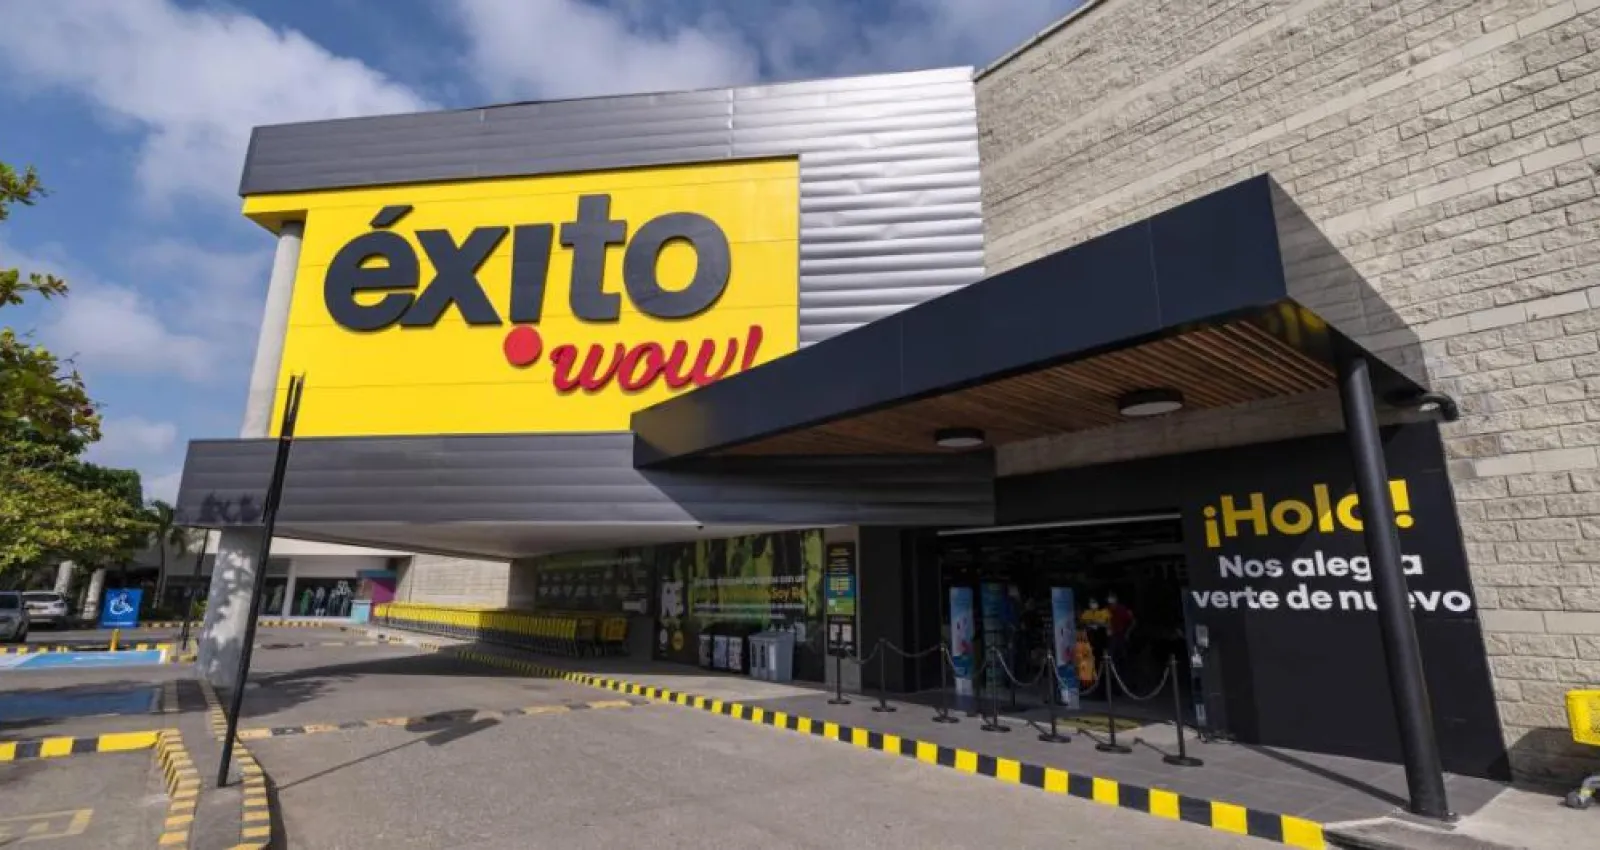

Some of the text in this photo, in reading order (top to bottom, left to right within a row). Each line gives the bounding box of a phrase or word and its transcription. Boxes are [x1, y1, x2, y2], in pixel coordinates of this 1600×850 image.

[323, 193, 732, 367] éxito
[550, 326, 762, 394] wow!
[1219, 555, 1283, 578] Nos
[1291, 550, 1423, 582] alega
[1192, 584, 1471, 612] verte de nuvo
